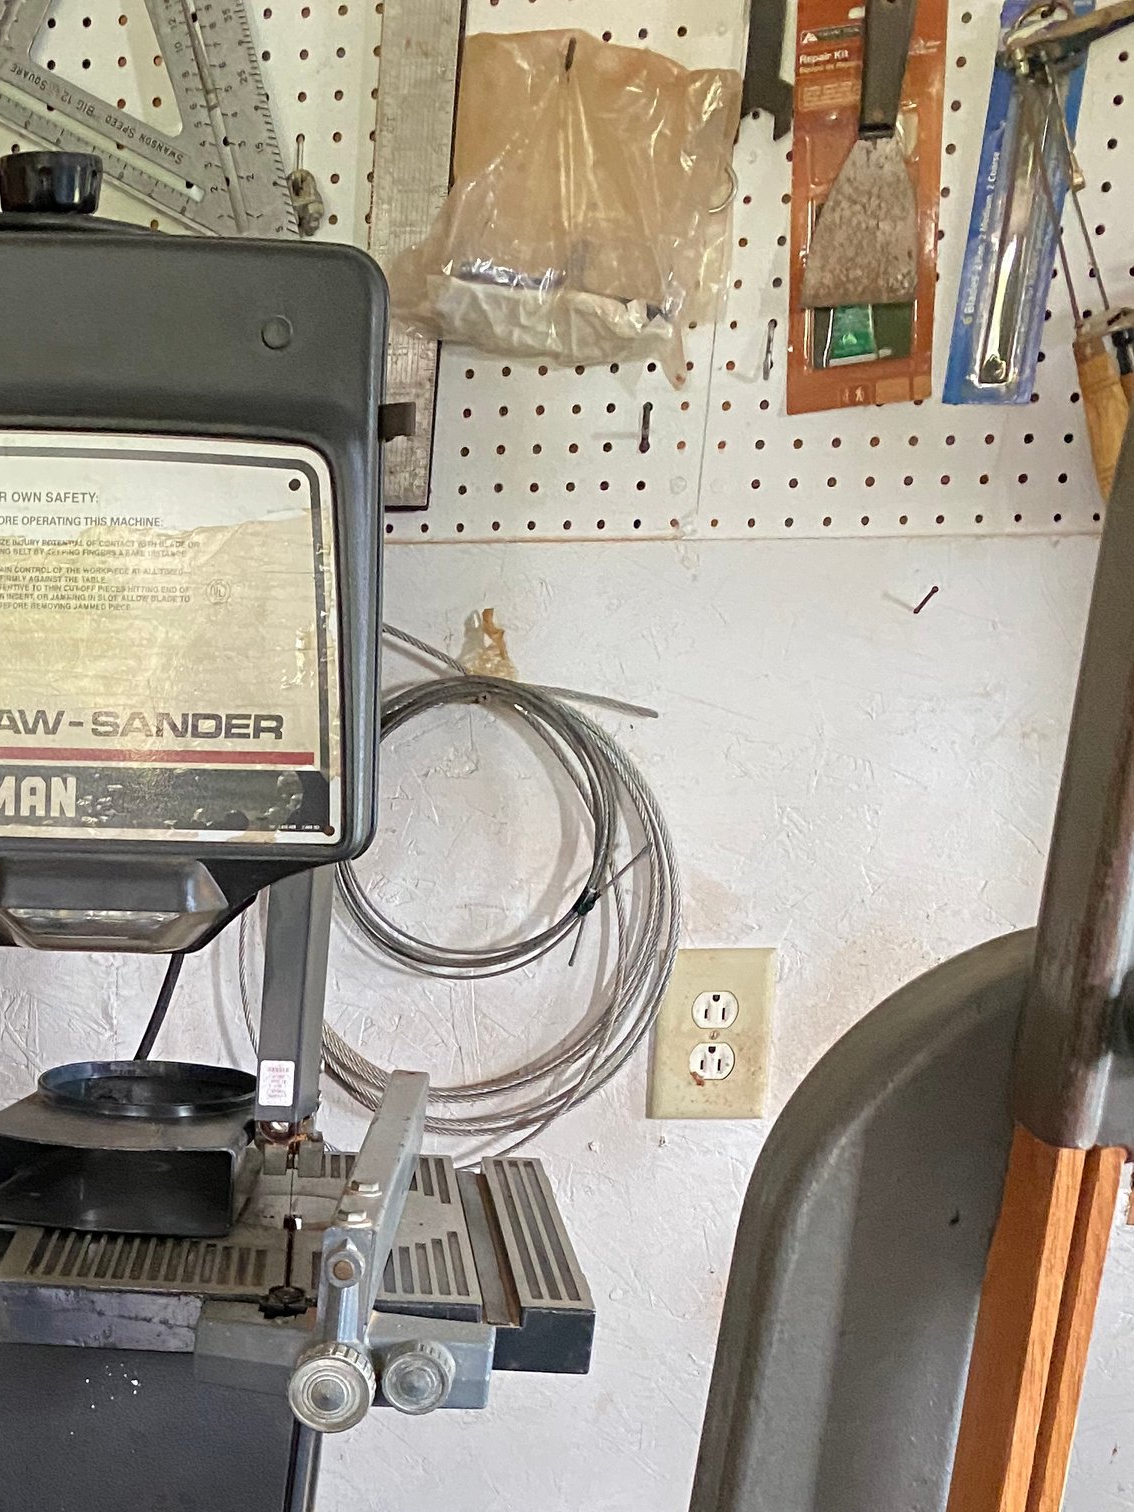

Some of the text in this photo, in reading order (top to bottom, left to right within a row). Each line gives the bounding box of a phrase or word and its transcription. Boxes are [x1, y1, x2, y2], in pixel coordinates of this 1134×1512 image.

[834, 49, 849, 60] Kit
[76, 99, 95, 116] BIG
[11, 491, 42, 503] OWN
[45, 492, 99, 504] SAFETY:
[21, 515, 81, 526] OPERATING
[84, 516, 107, 526] THIS
[110, 516, 164, 528] MACHINE:
